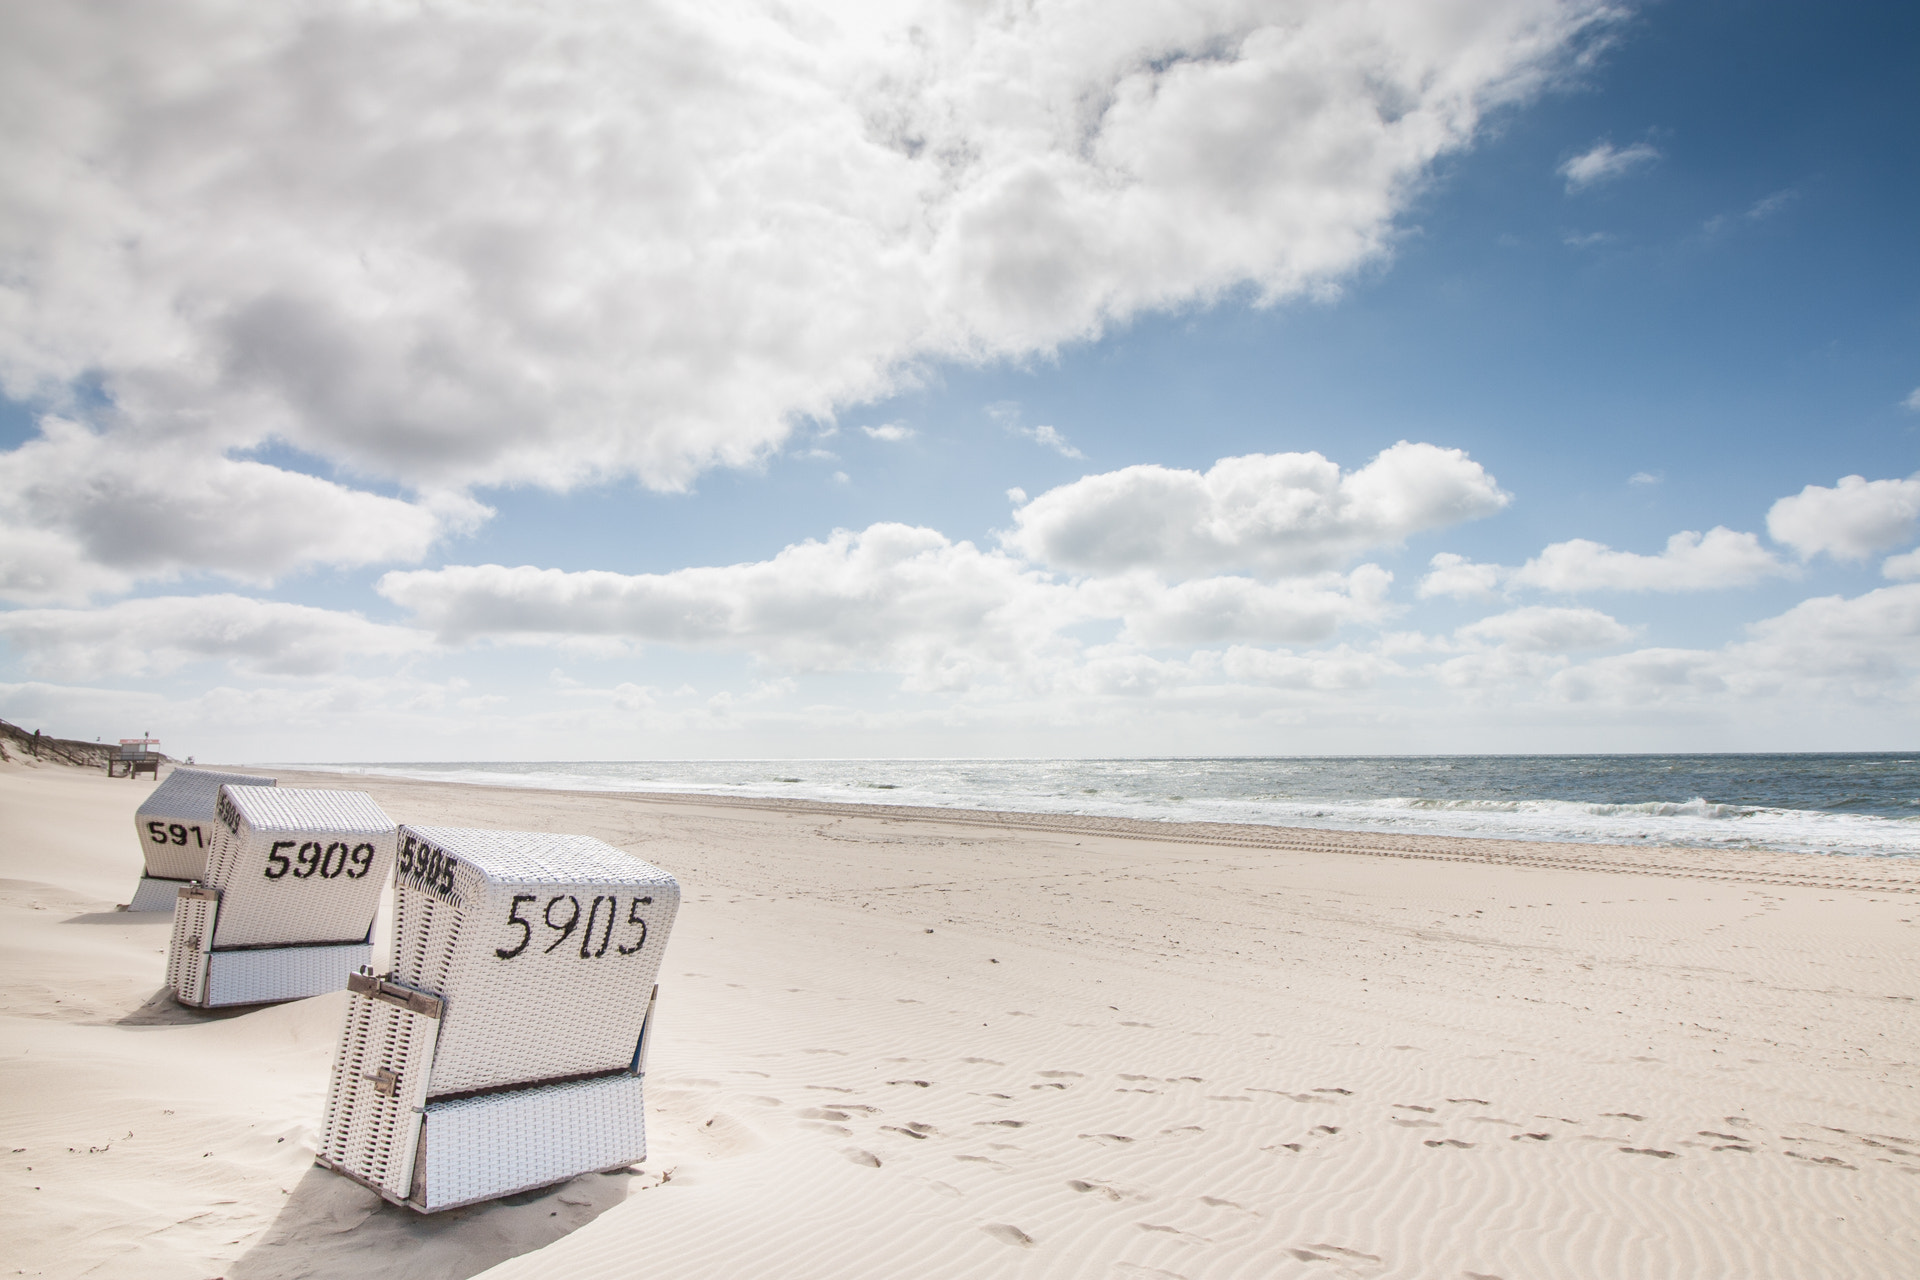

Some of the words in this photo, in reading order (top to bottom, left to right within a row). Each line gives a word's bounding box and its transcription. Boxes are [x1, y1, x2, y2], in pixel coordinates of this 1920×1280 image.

[218, 794, 241, 834] 5909
[148, 821, 212, 848] 591
[264, 841, 376, 879] 5909
[400, 836, 457, 894] 5905
[496, 895, 652, 959] 5905
